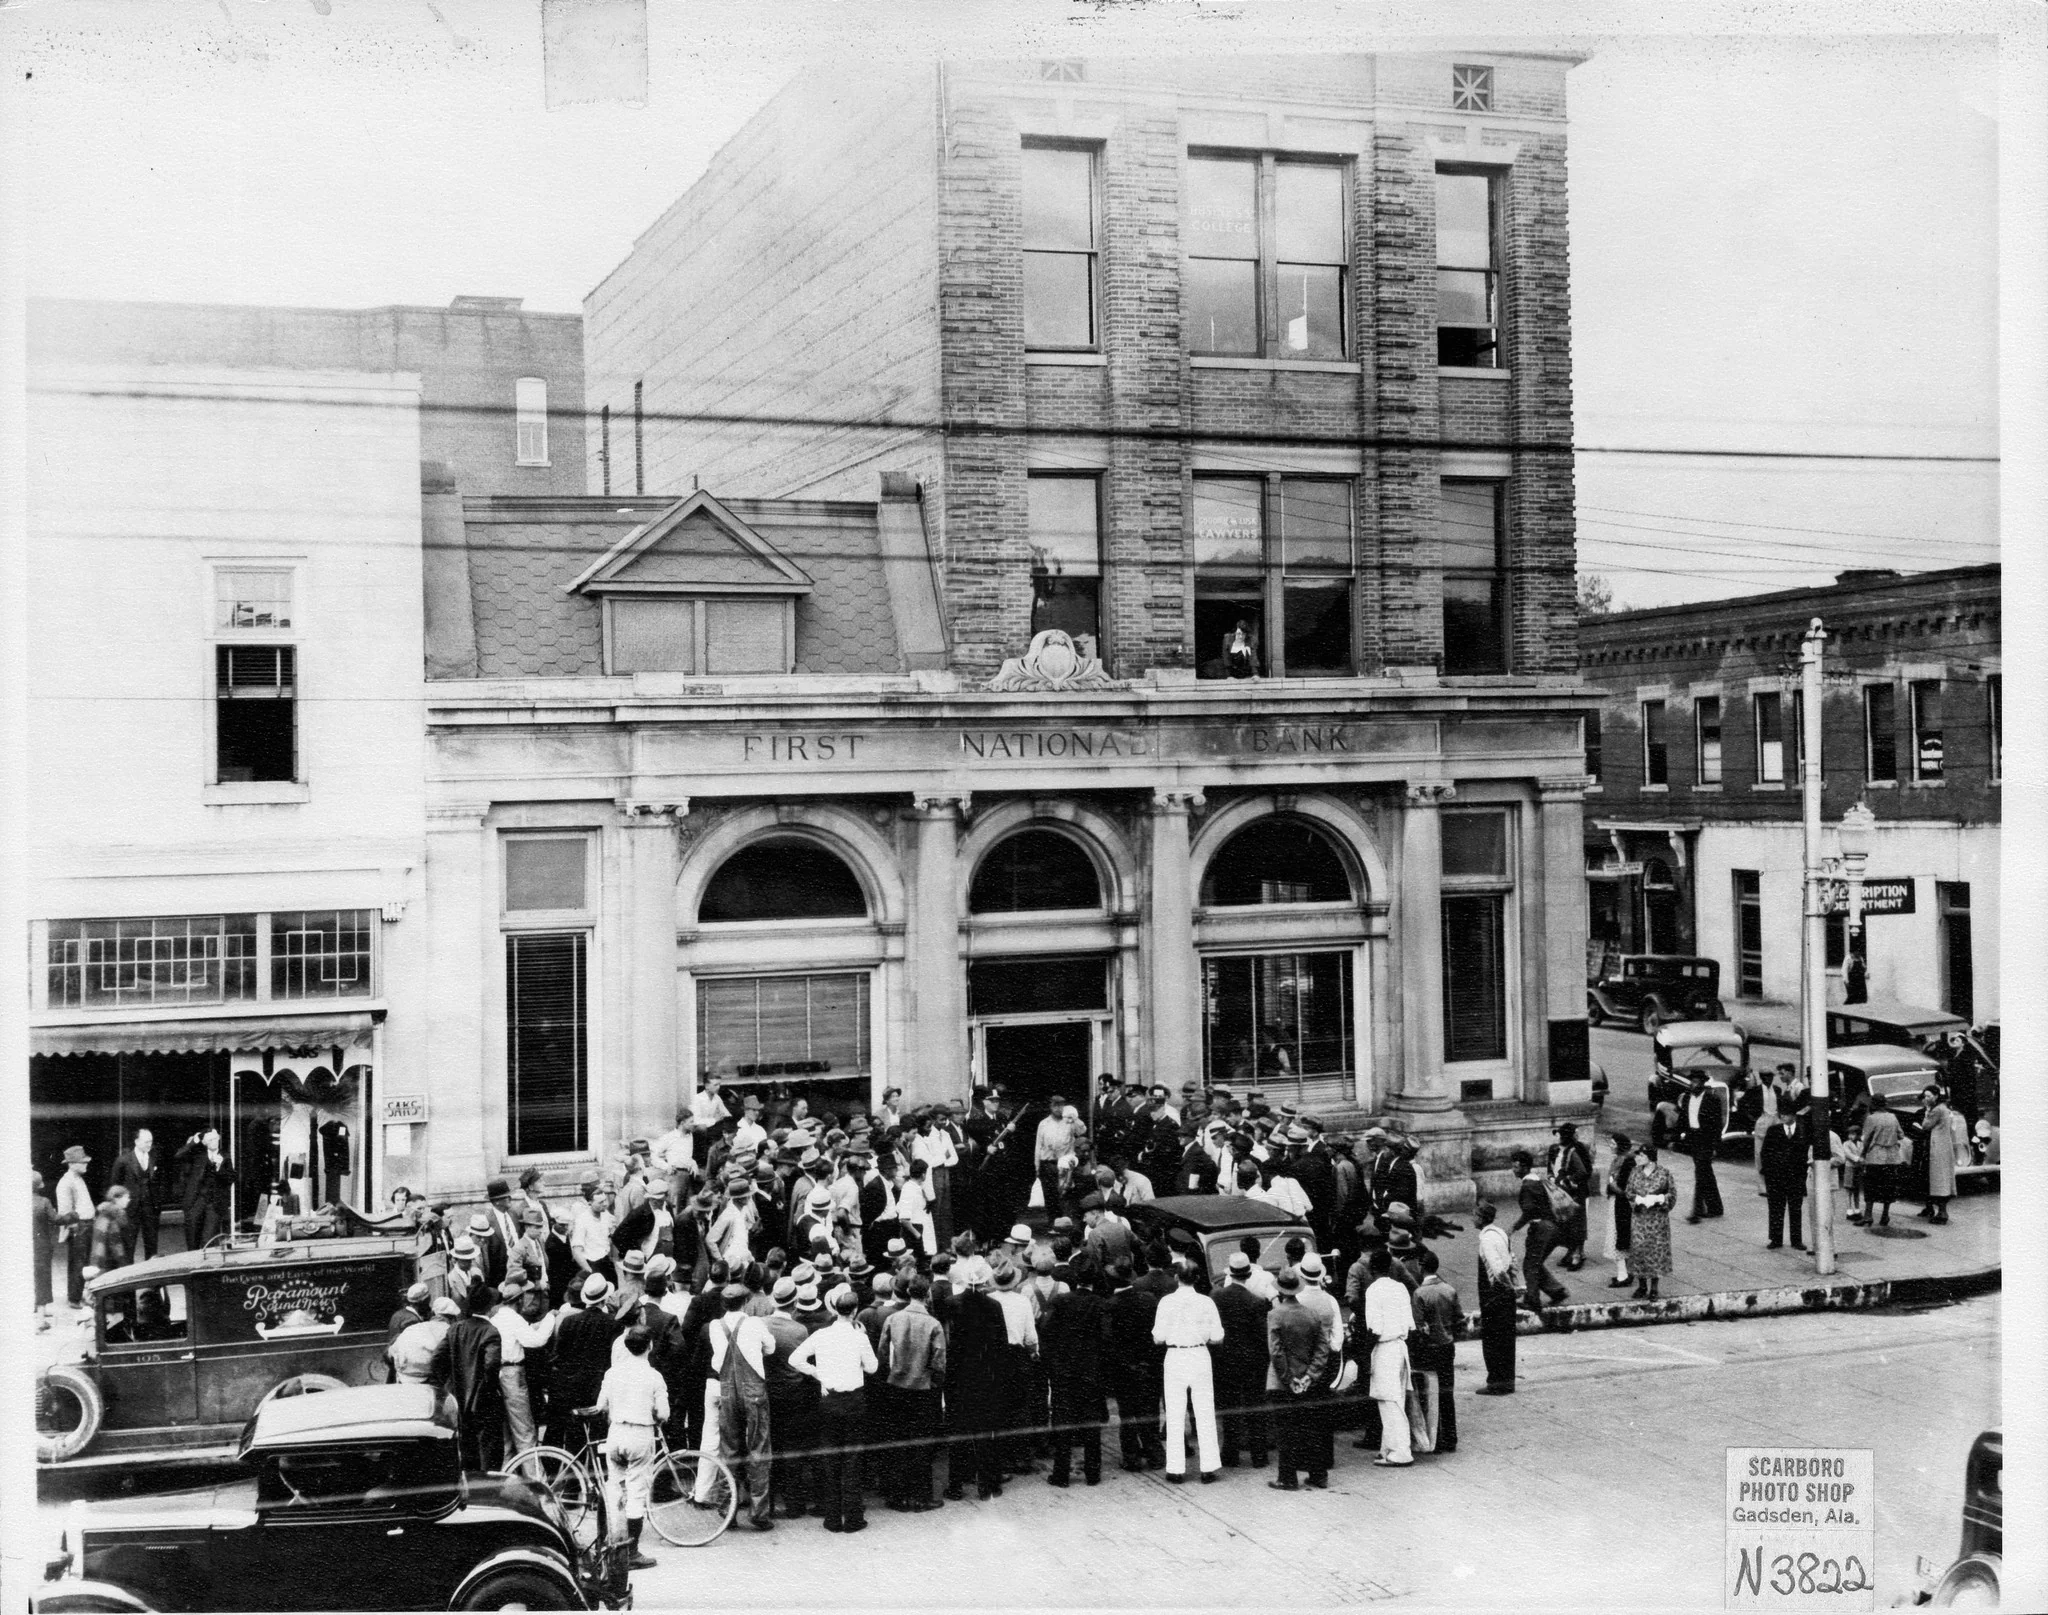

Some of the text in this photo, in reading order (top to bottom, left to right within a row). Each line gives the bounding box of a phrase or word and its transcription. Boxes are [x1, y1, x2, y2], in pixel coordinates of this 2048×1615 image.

[1191, 220, 1251, 233] COLLEGE
[1199, 529, 1258, 539] LAWYERS
[743, 727, 1348, 761] FIRST NATIONAL BANK
[1832, 899, 1903, 911] DERTMENT
[267, 1271, 285, 1281] and
[243, 1282, 350, 1310] Paramount
[255, 1296, 339, 1320] Sound News
